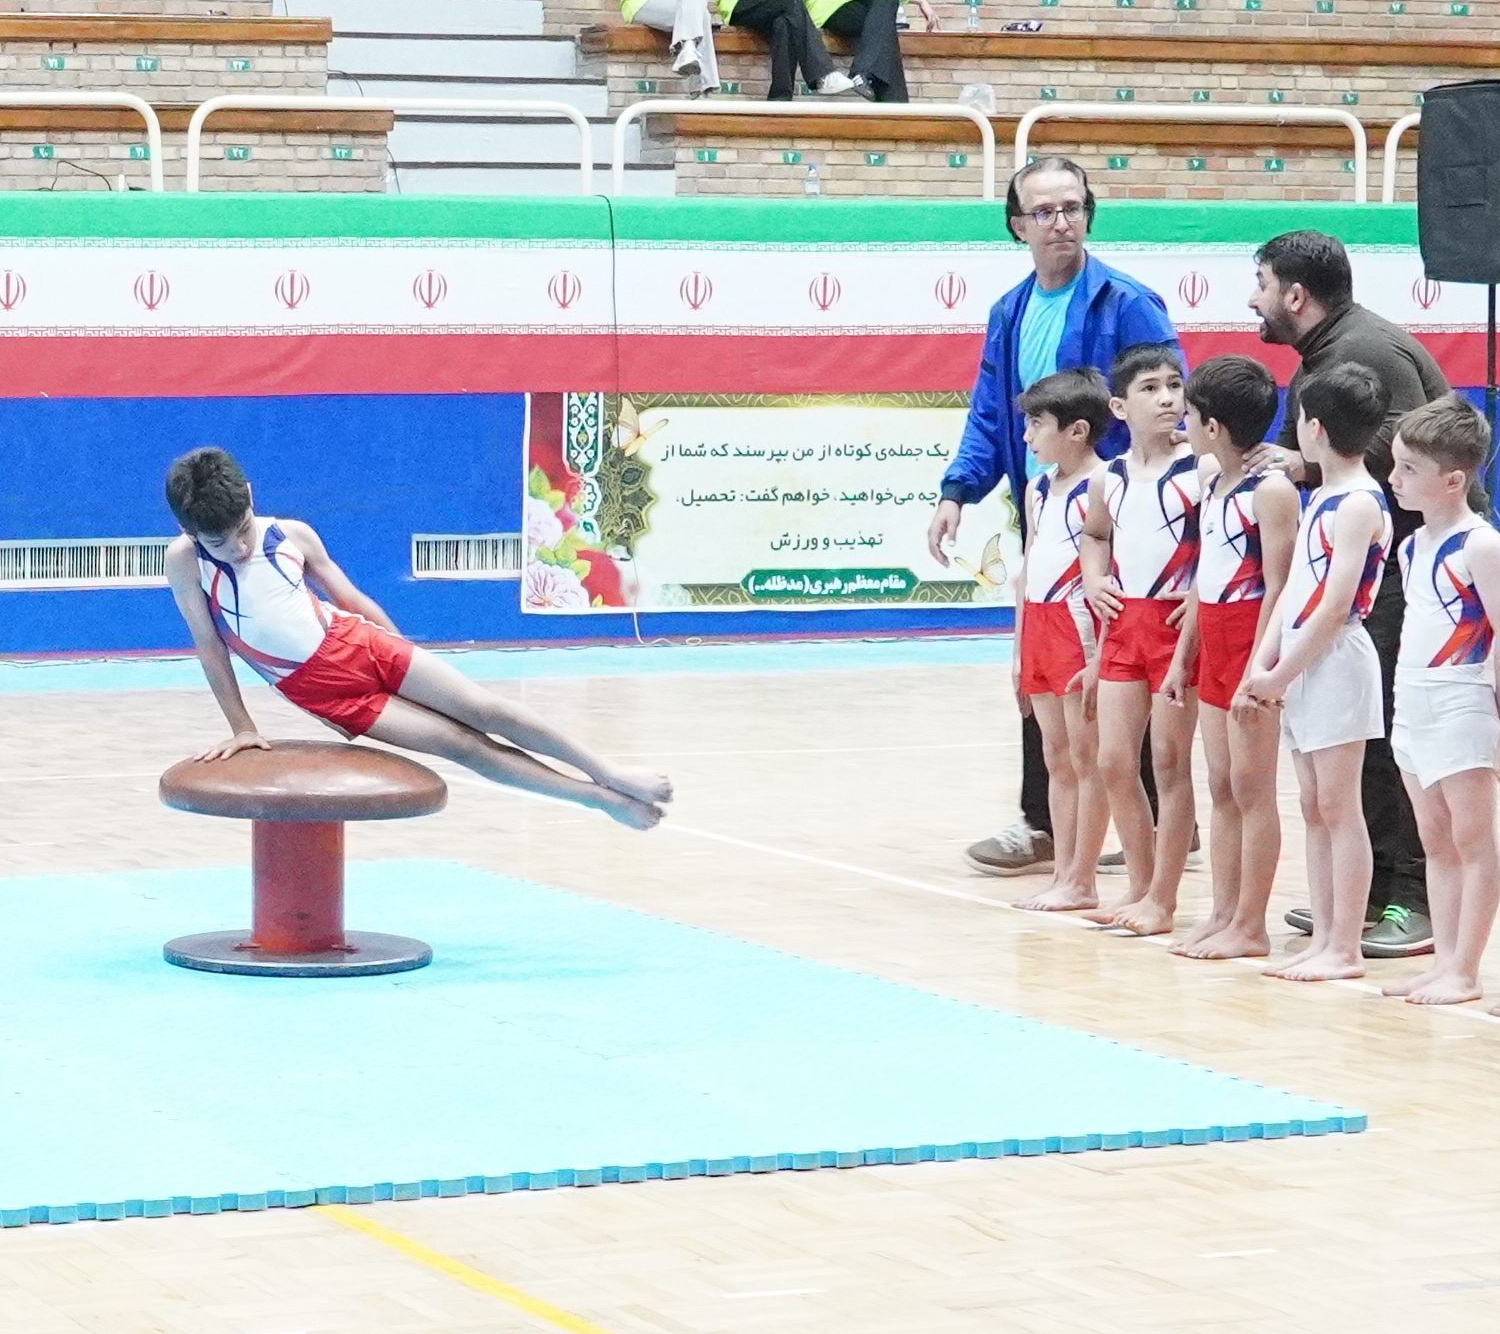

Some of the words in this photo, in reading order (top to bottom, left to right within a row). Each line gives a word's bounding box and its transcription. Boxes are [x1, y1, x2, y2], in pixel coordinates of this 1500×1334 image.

[660, 443, 675, 462] از
[678, 442, 708, 458] شما
[710, 442, 730, 458] که
[792, 447, 815, 462] من
[818, 443, 832, 462] از
[834, 442, 872, 461] کوتاه
[925, 442, 950, 461] یک
[781, 488, 831, 506] خواهم
[917, 491, 938, 508] چه
[770, 531, 819, 551] ورزش
[822, 536, 831, 551] و
[833, 530, 884, 550] تهذیب
